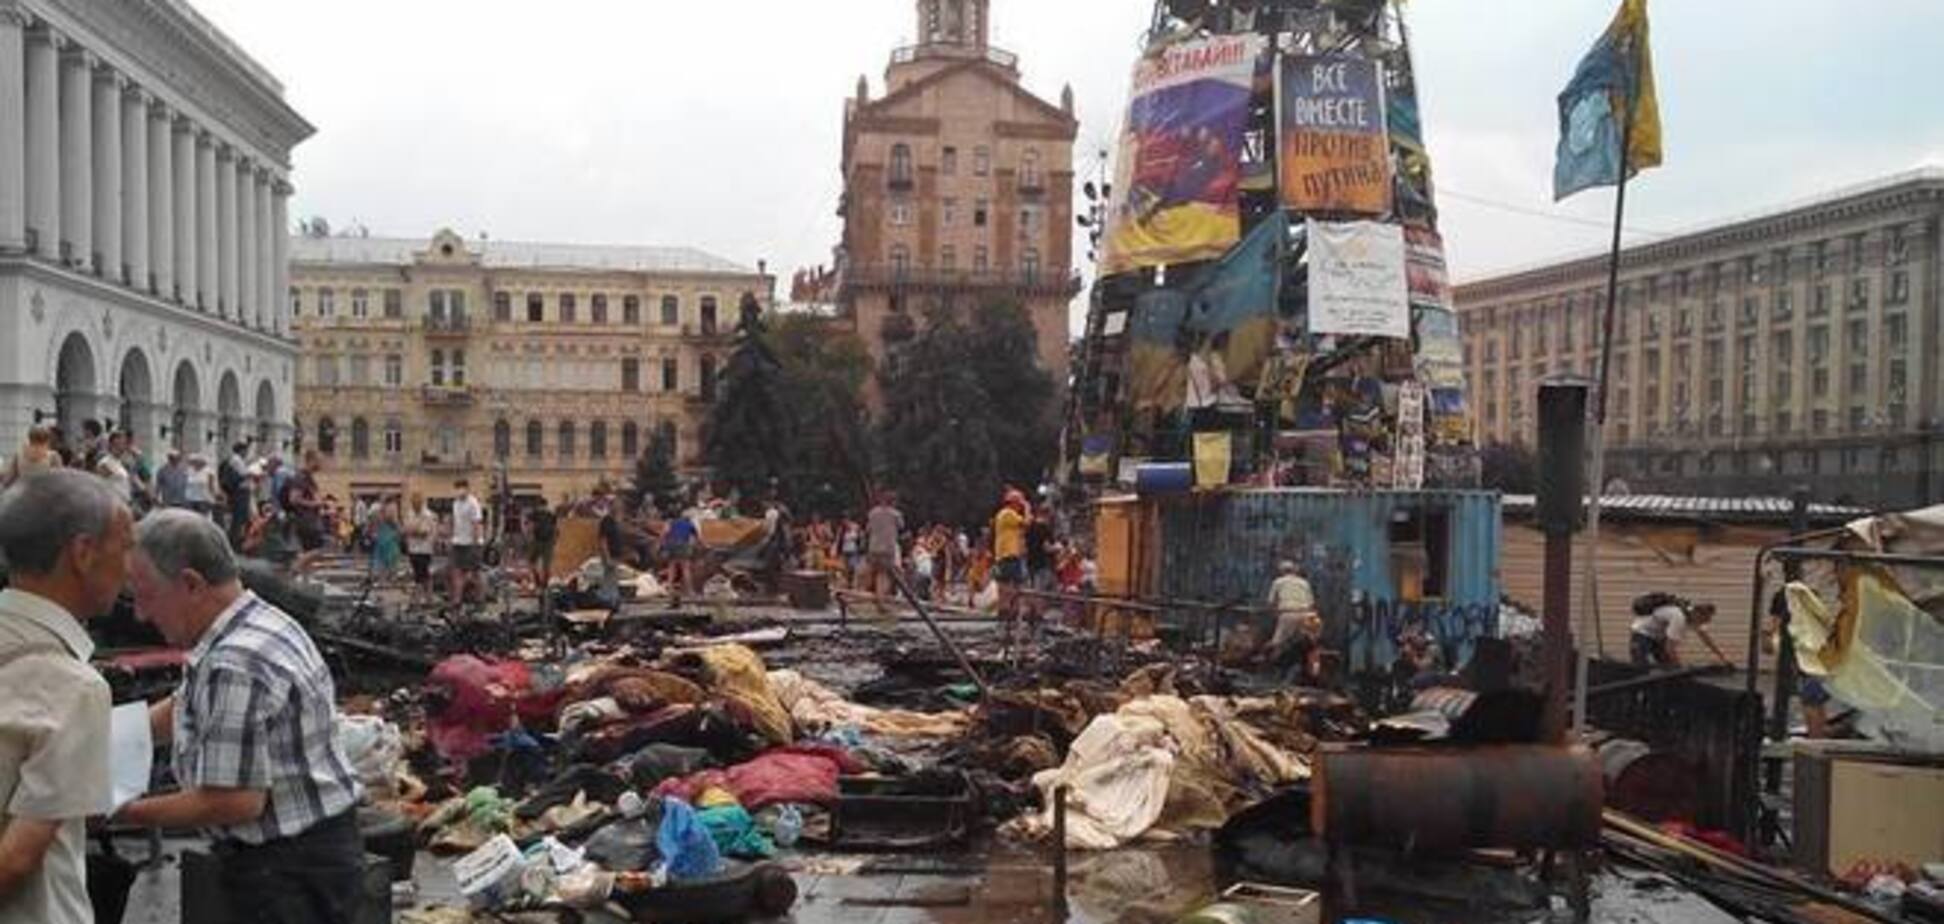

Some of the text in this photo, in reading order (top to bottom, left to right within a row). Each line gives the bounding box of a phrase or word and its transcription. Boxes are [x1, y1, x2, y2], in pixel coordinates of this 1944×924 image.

[1295, 96, 1369, 126] ВМЕСТЕ
[1295, 131, 1370, 158] ПРОТИВ
[1302, 161, 1382, 201] ПУТИНА
